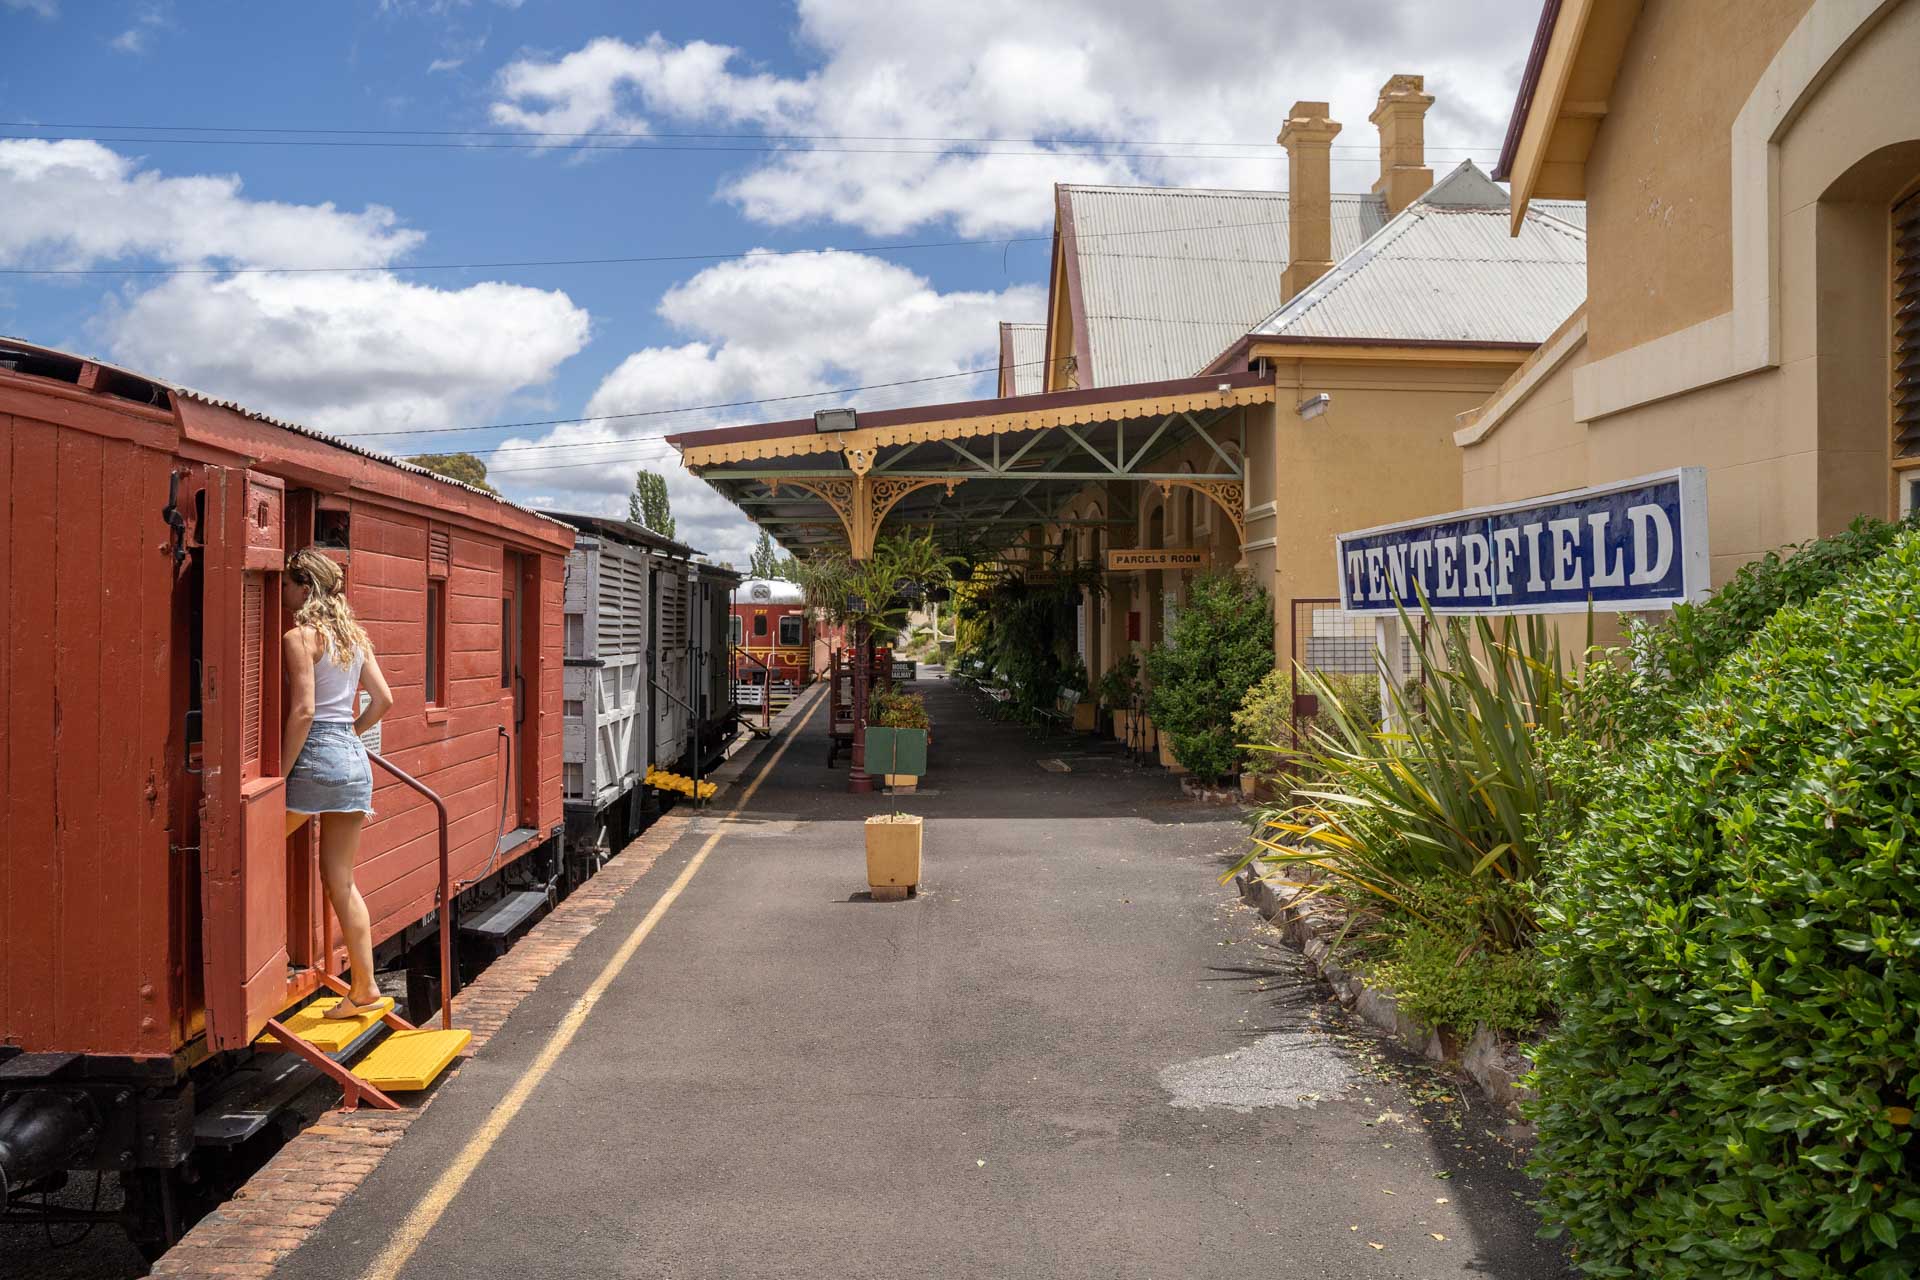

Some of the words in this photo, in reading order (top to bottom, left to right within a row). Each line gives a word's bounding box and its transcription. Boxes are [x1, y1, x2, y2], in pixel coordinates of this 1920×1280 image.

[1116, 555, 1166, 564] PARCELS
[1171, 554, 1201, 563] ROOM
[1348, 504, 1674, 601] TENTERFIELD
